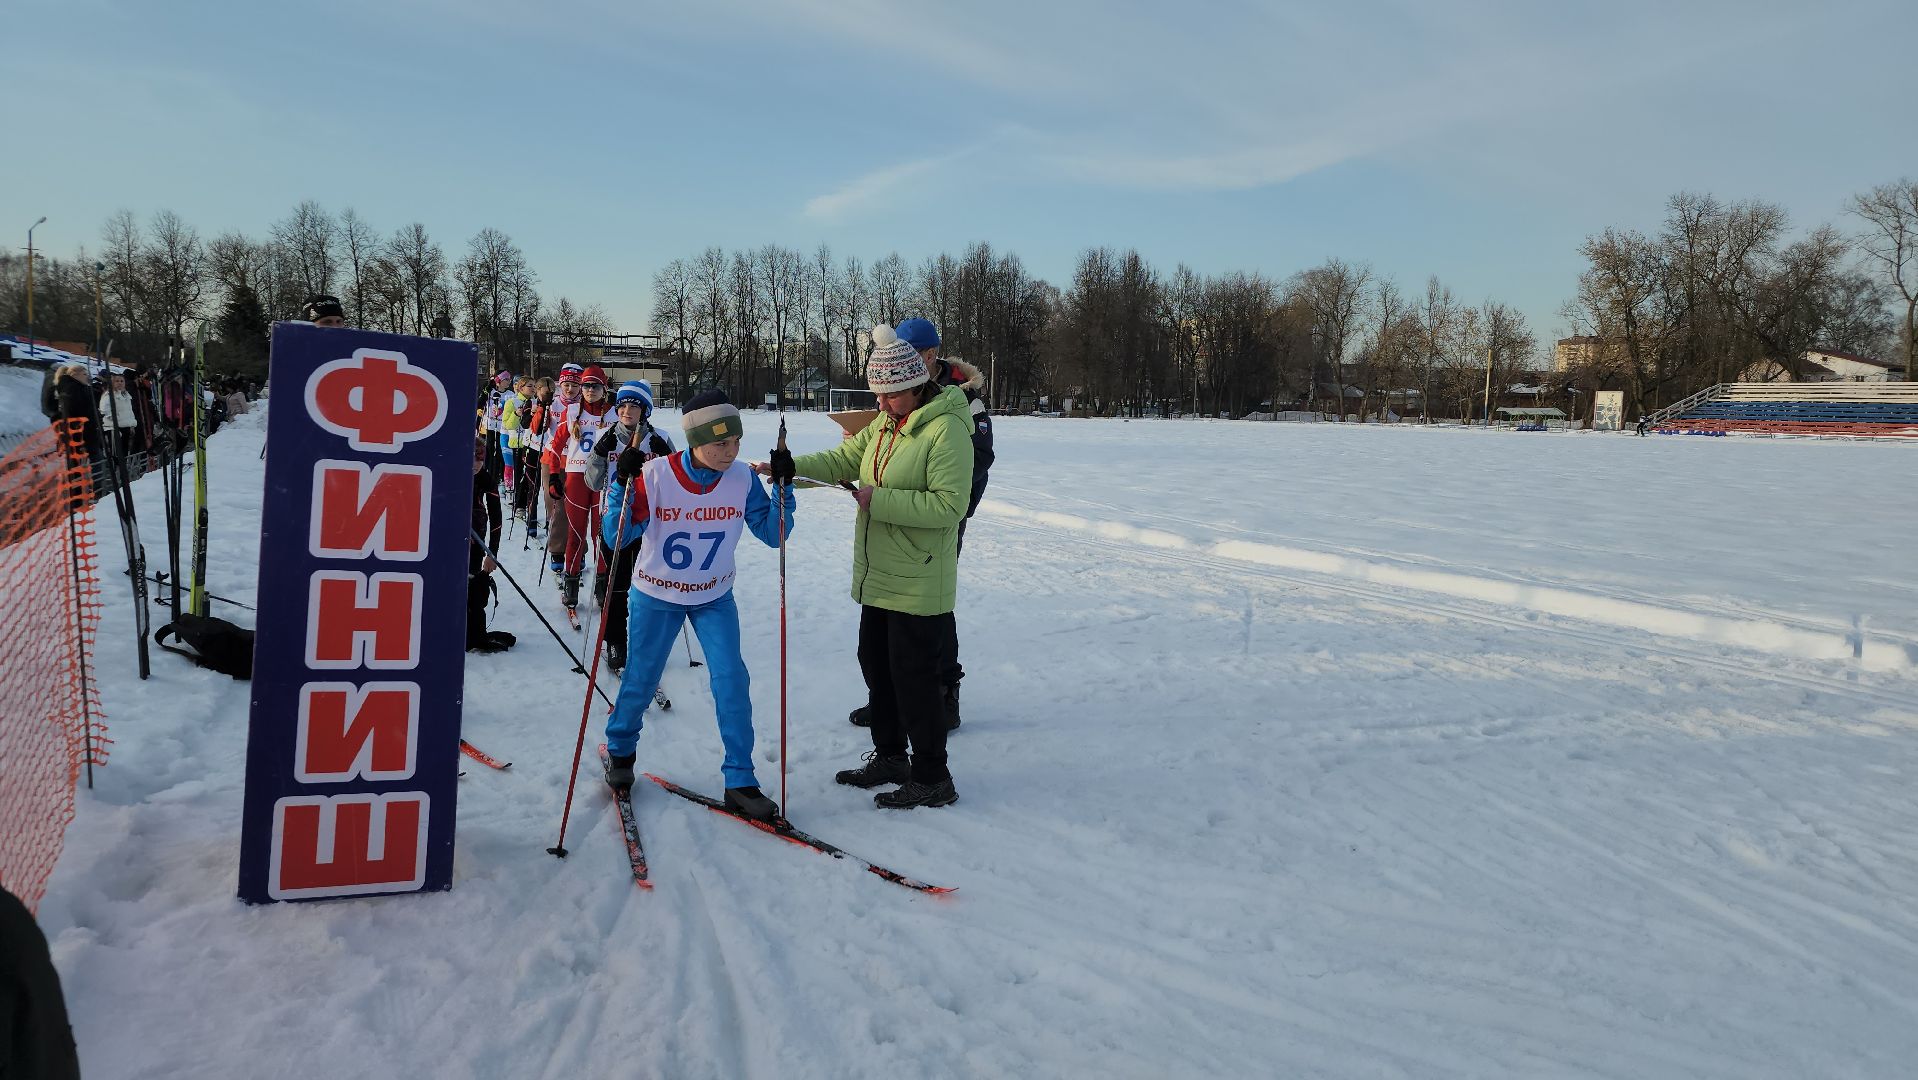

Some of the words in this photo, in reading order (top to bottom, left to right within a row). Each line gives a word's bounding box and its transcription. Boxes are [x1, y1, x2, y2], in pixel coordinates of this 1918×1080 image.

[685, 507, 743, 521] «СШОР»
[662, 530, 726, 571] 67
[638, 568, 718, 594] Богородский
[273, 352, 443, 895] ФИНИШ
